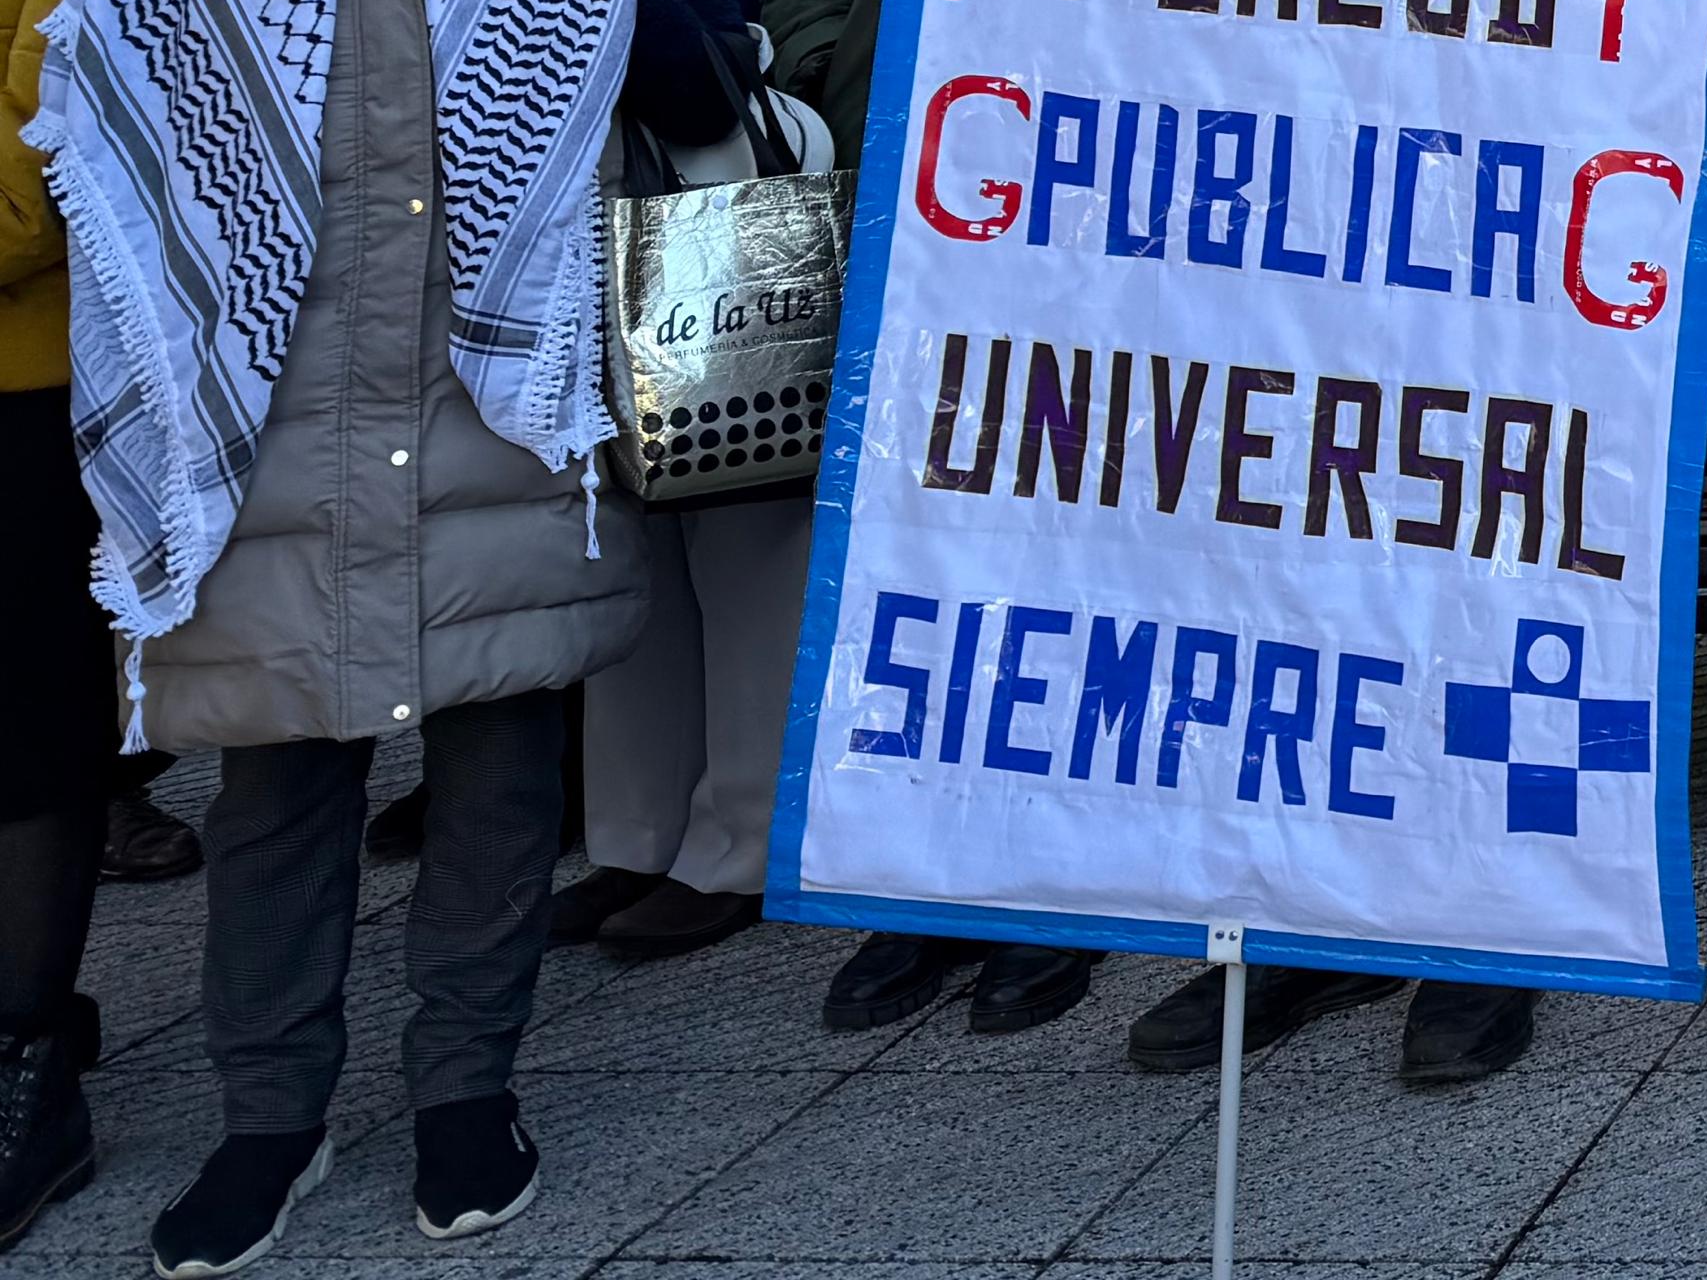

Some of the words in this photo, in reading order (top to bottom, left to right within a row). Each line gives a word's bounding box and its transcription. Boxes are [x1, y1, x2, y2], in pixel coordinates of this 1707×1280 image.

[1027, 92, 1544, 302] PUBLICA
[656, 301, 699, 346] de
[712, 293, 750, 336] la
[923, 333, 1626, 581] UNIVERSAL
[851, 591, 1404, 821] SIEMPRE
